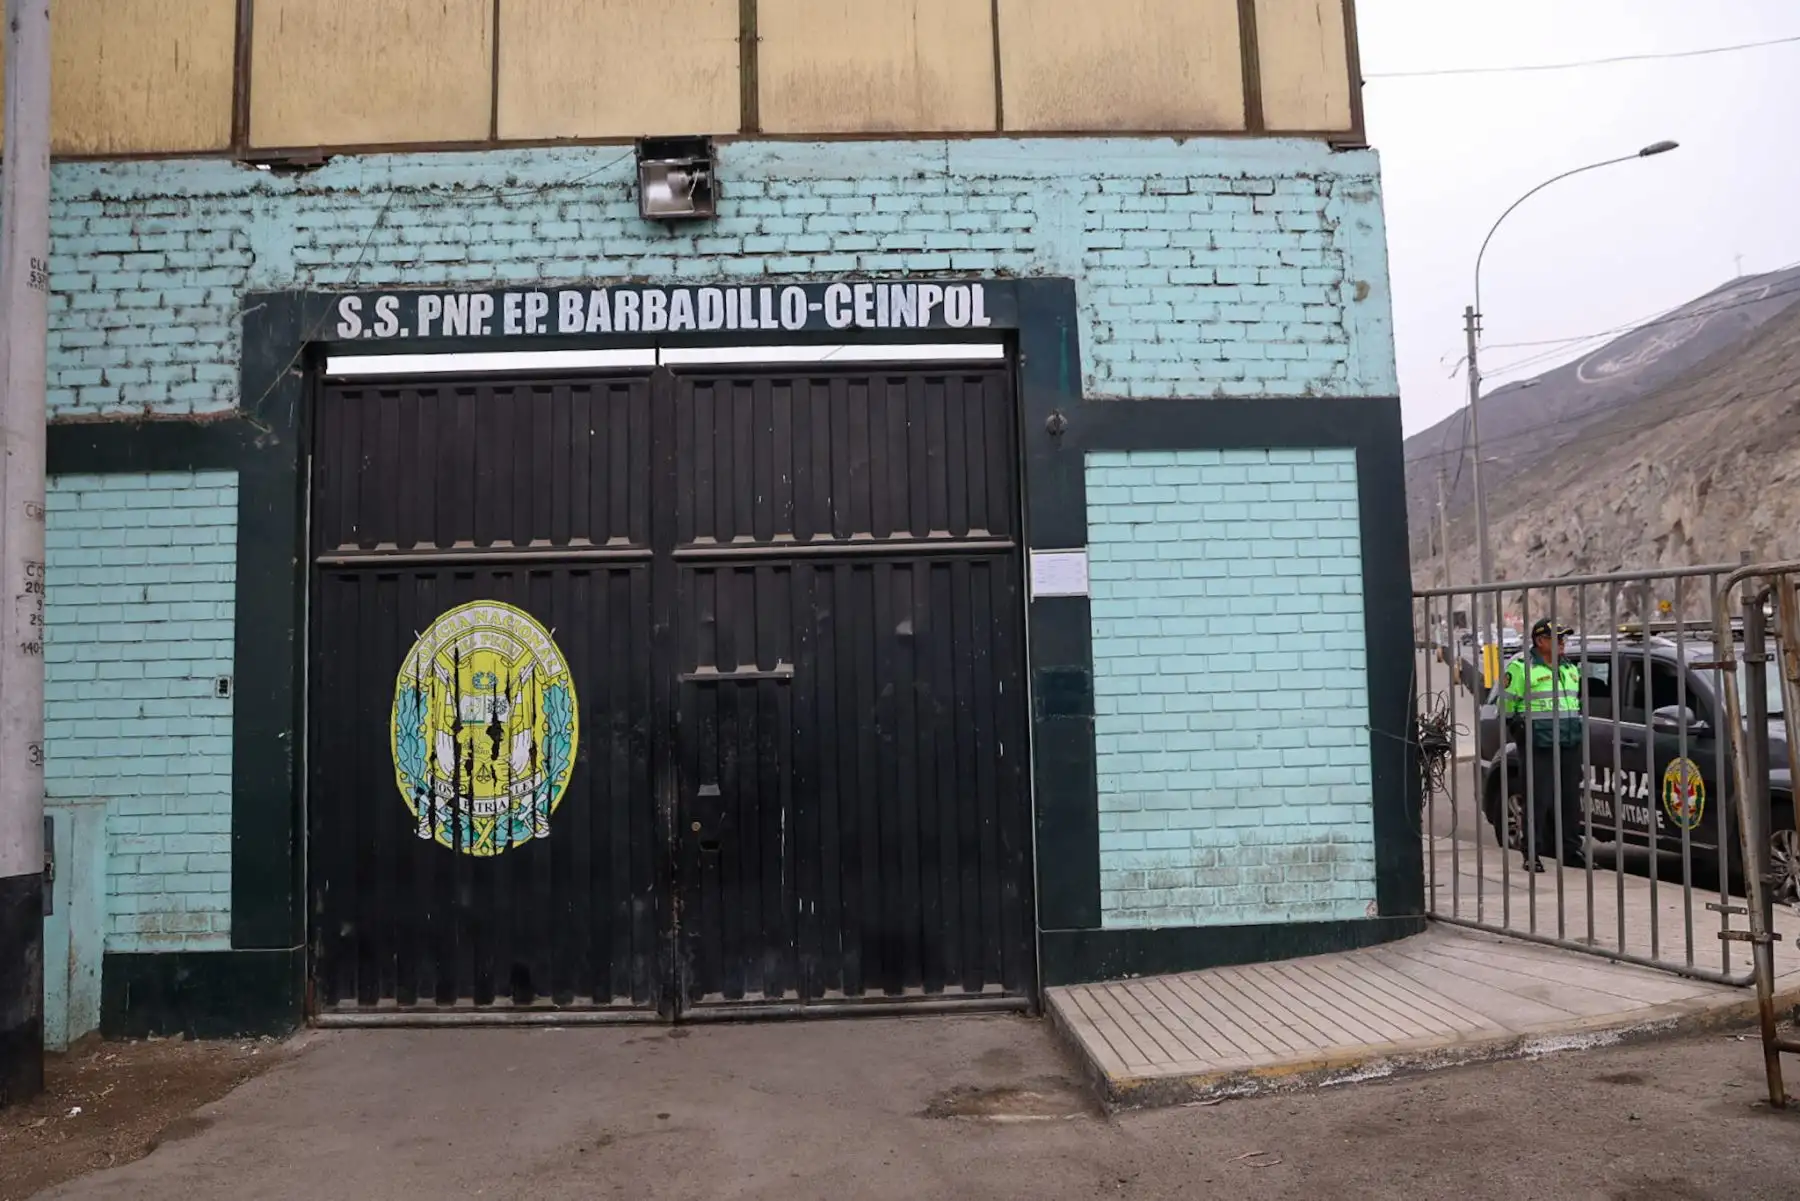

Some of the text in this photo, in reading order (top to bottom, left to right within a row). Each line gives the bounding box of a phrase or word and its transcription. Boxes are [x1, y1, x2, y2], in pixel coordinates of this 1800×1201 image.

[337, 282, 991, 338] S.S. PNP. EP. BARBADILLO-CEINPOL
[408, 615, 471, 674] OLICIA
[1579, 764, 1655, 799] LICIA
[463, 800, 507, 814] PTRIA
